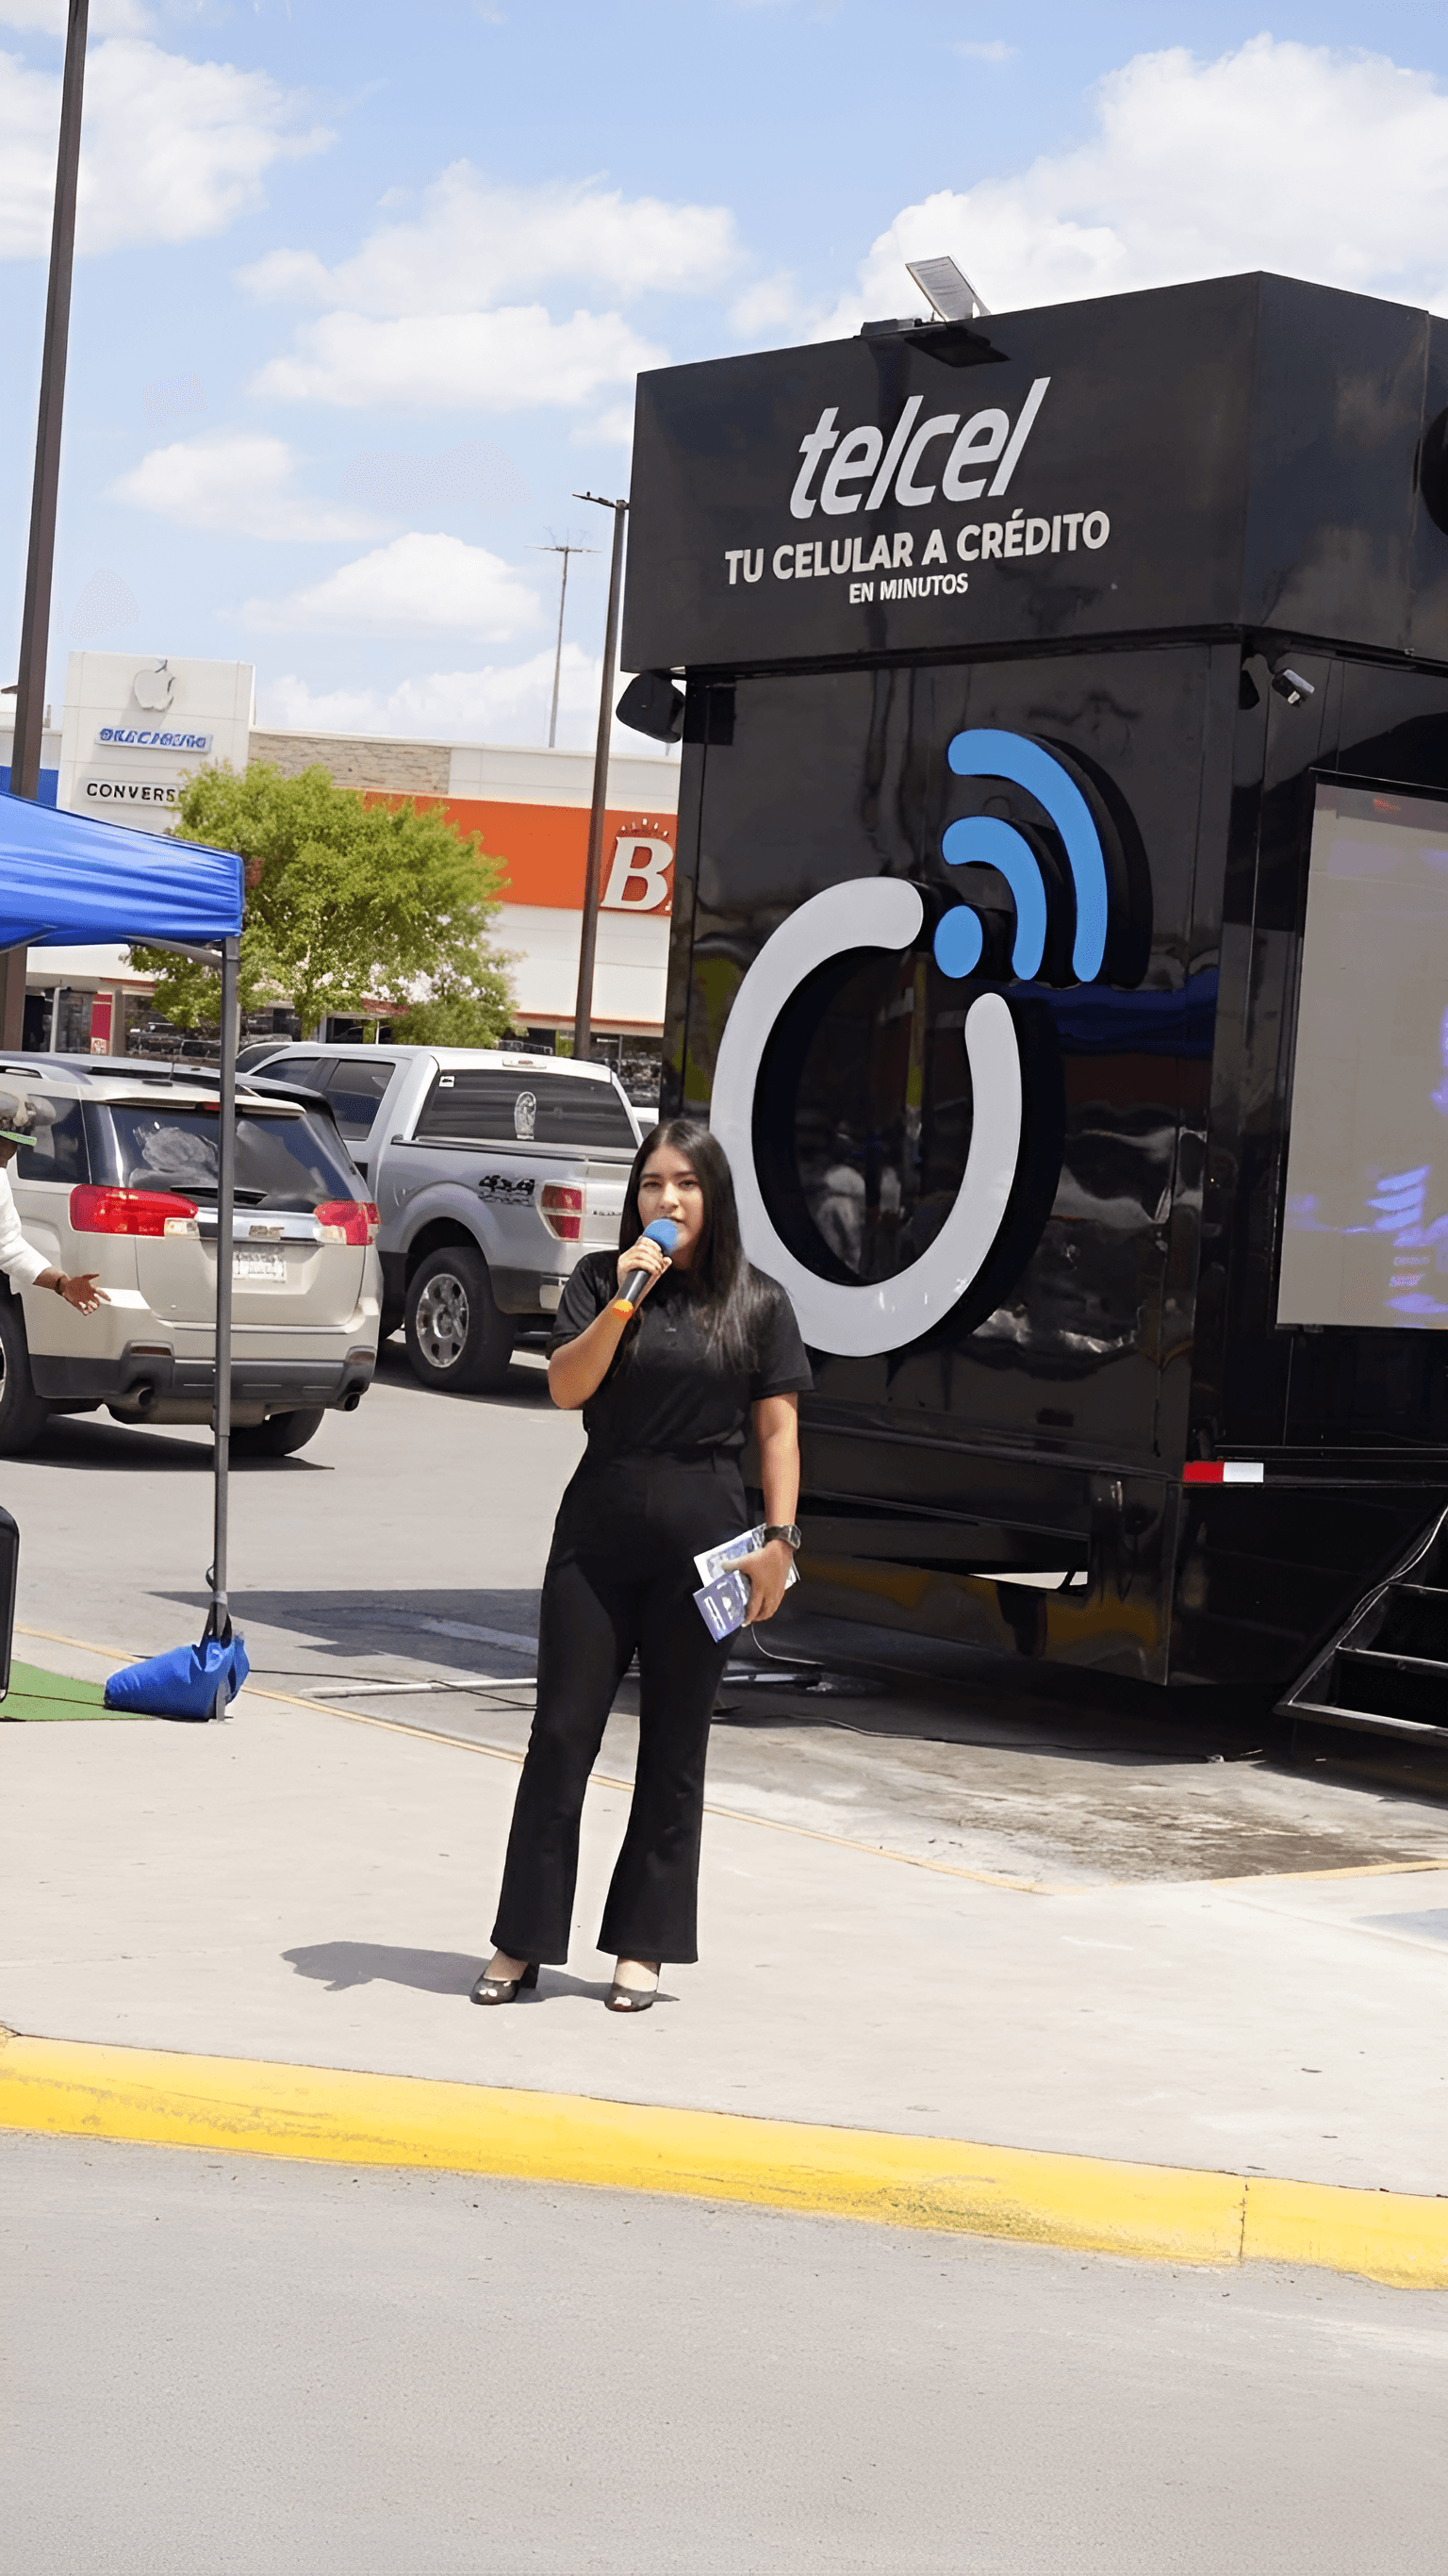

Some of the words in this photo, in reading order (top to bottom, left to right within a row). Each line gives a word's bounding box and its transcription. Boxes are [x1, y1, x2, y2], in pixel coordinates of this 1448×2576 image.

[789, 376, 1052, 520] telcel
[725, 548, 765, 586] TU
[771, 531, 914, 581] CELULAR
[921, 528, 948, 566] A
[956, 507, 1111, 562] CRÉDITO
[849, 582, 874, 604] EN
[880, 572, 969, 601] MINUTOS
[86, 782, 176, 803] CONVERS
[600, 835, 674, 913] B
